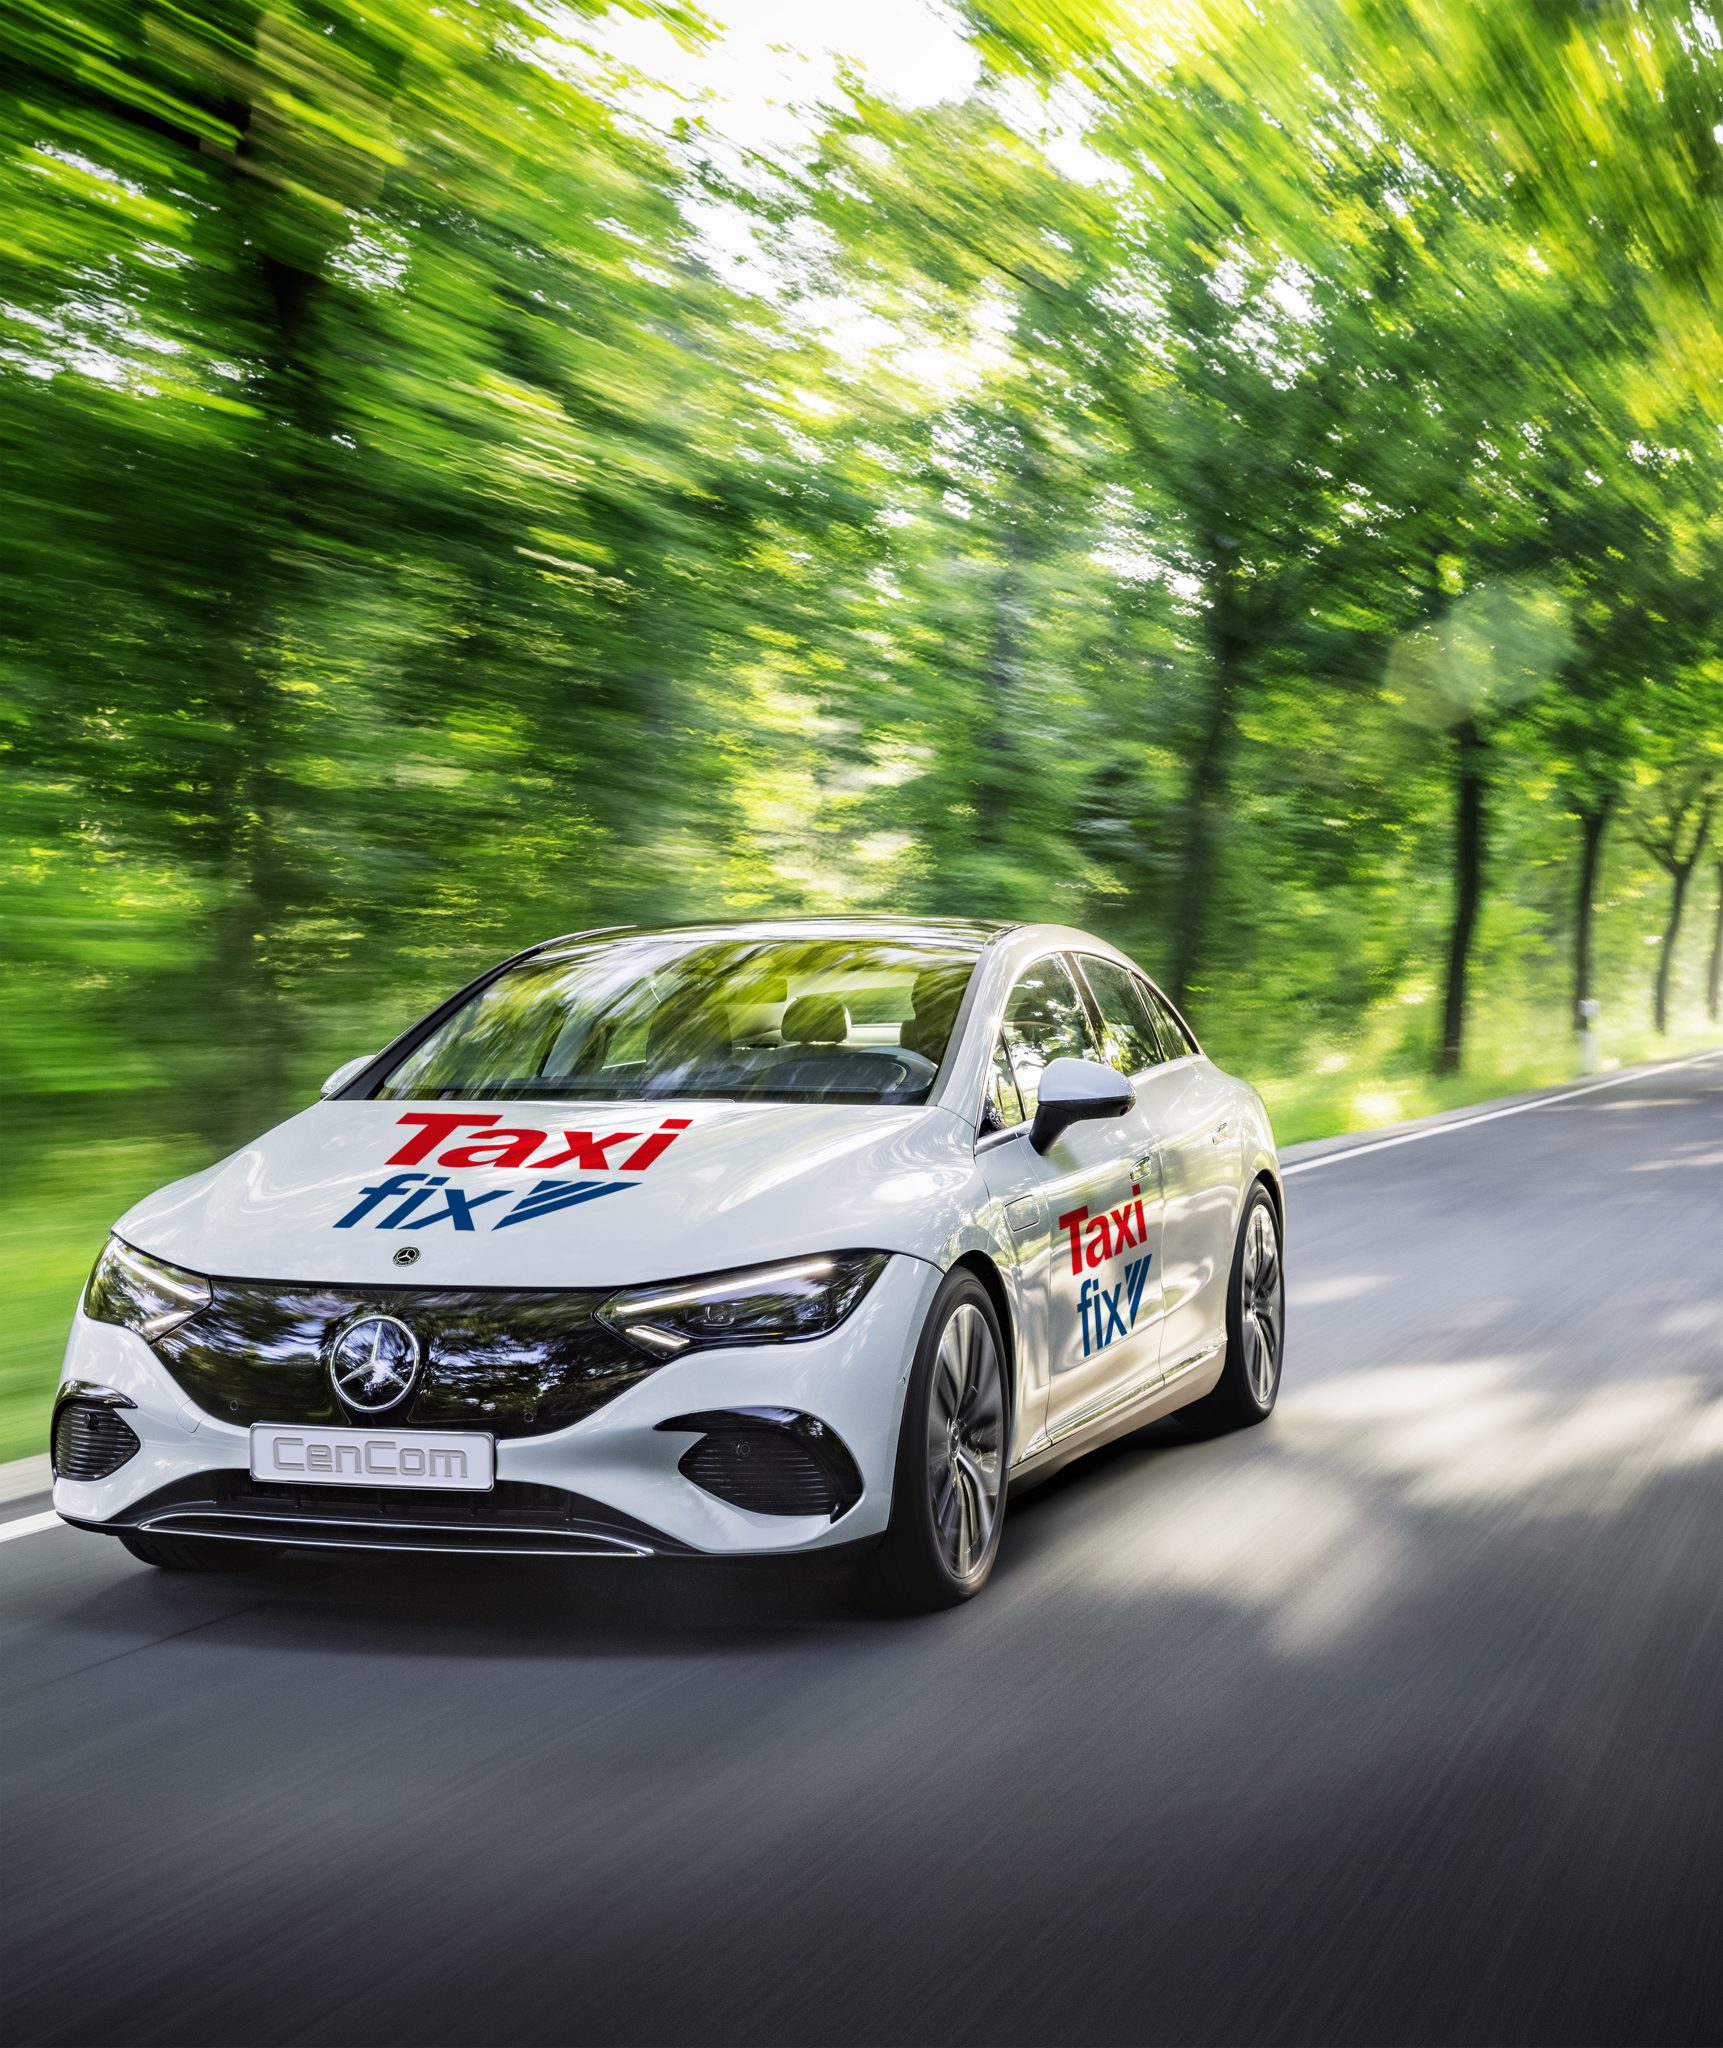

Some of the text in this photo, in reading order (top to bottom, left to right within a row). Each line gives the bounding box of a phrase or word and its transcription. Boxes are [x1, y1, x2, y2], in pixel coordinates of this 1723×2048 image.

[384, 1112, 694, 1171] Taxi
[332, 1173, 514, 1232] fix
[1058, 1183, 1148, 1276] Taxi
[1077, 1278, 1128, 1358] fix
[272, 1436, 469, 1479] CenCom
